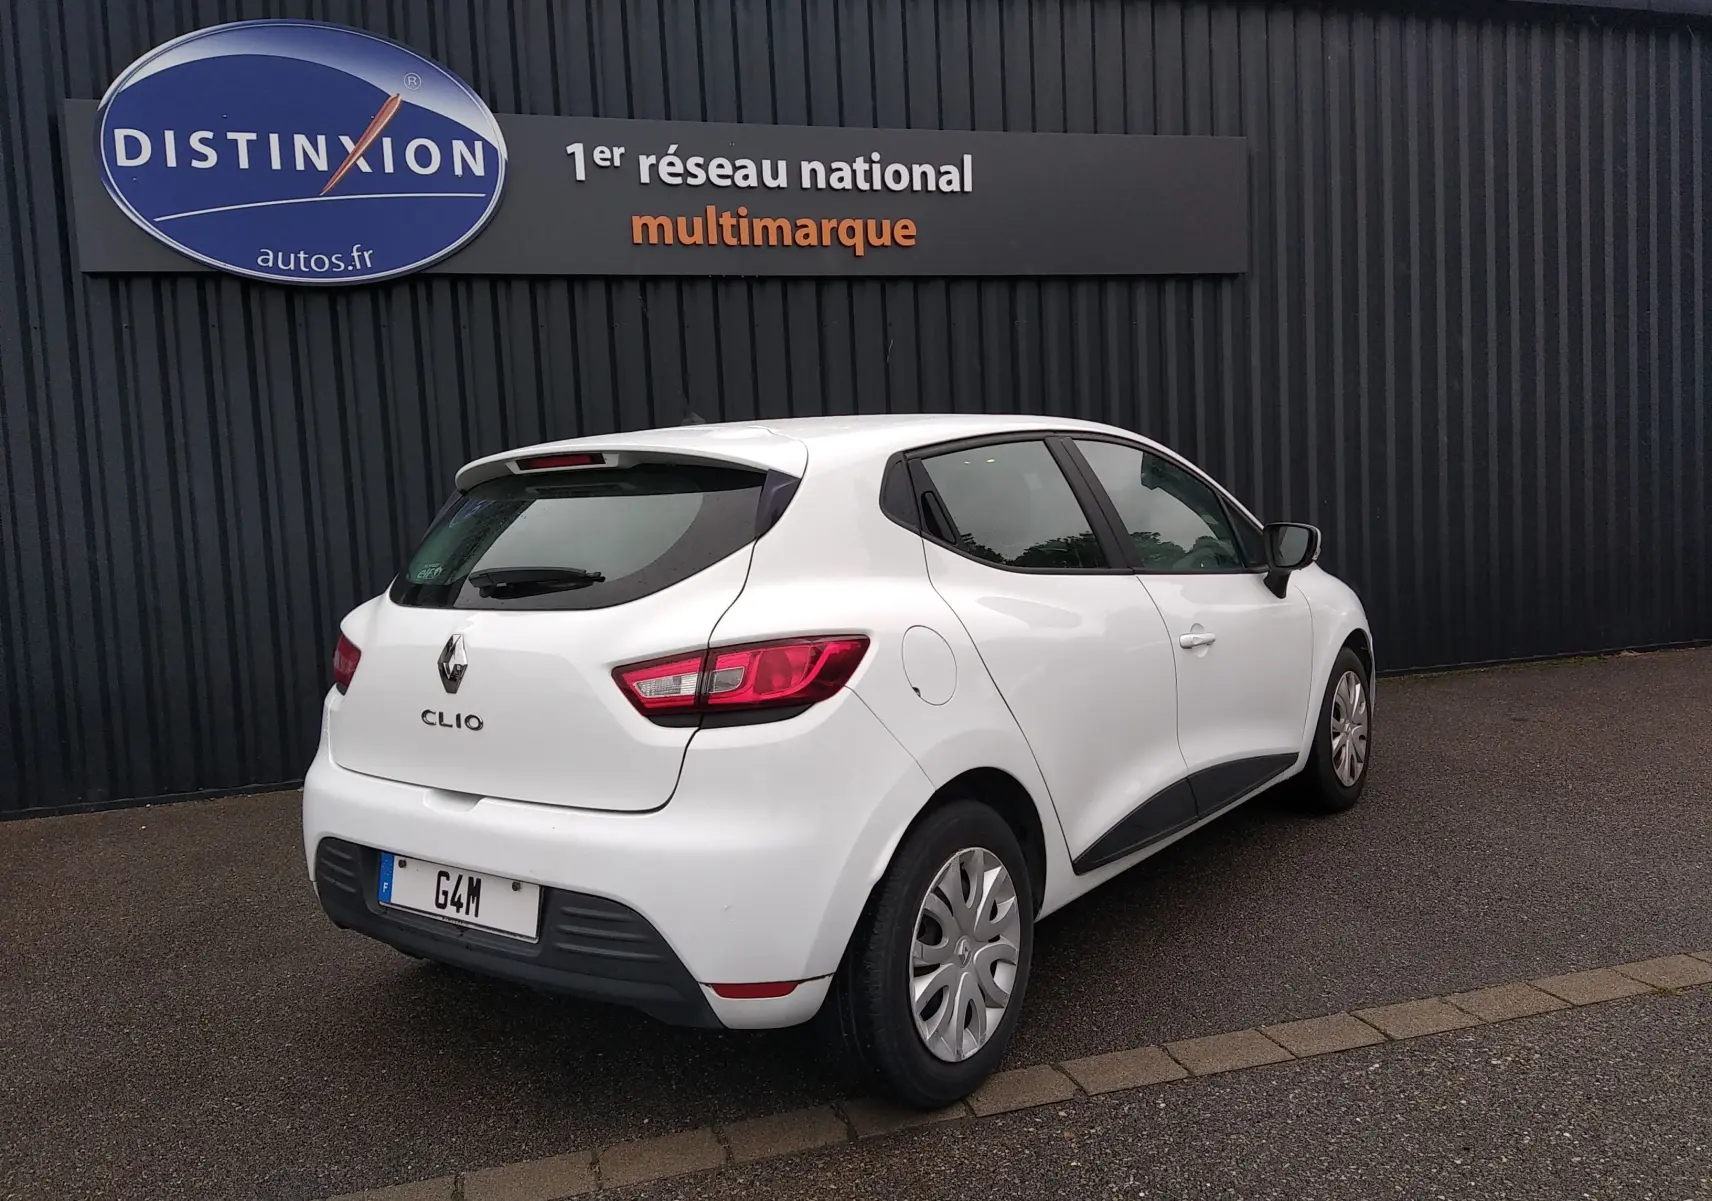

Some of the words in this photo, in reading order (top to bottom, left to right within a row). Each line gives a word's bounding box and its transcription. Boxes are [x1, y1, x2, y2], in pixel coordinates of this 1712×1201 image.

[113, 128, 486, 178] DISTINXION
[565, 142, 625, 182] 1er
[638, 144, 788, 189] réseau
[800, 151, 973, 193] national
[631, 205, 917, 257] multimarque
[256, 244, 374, 273] autos.fr
[420, 708, 484, 731] CLIO
[382, 881, 389, 893] F
[434, 870, 482, 918] G4M
